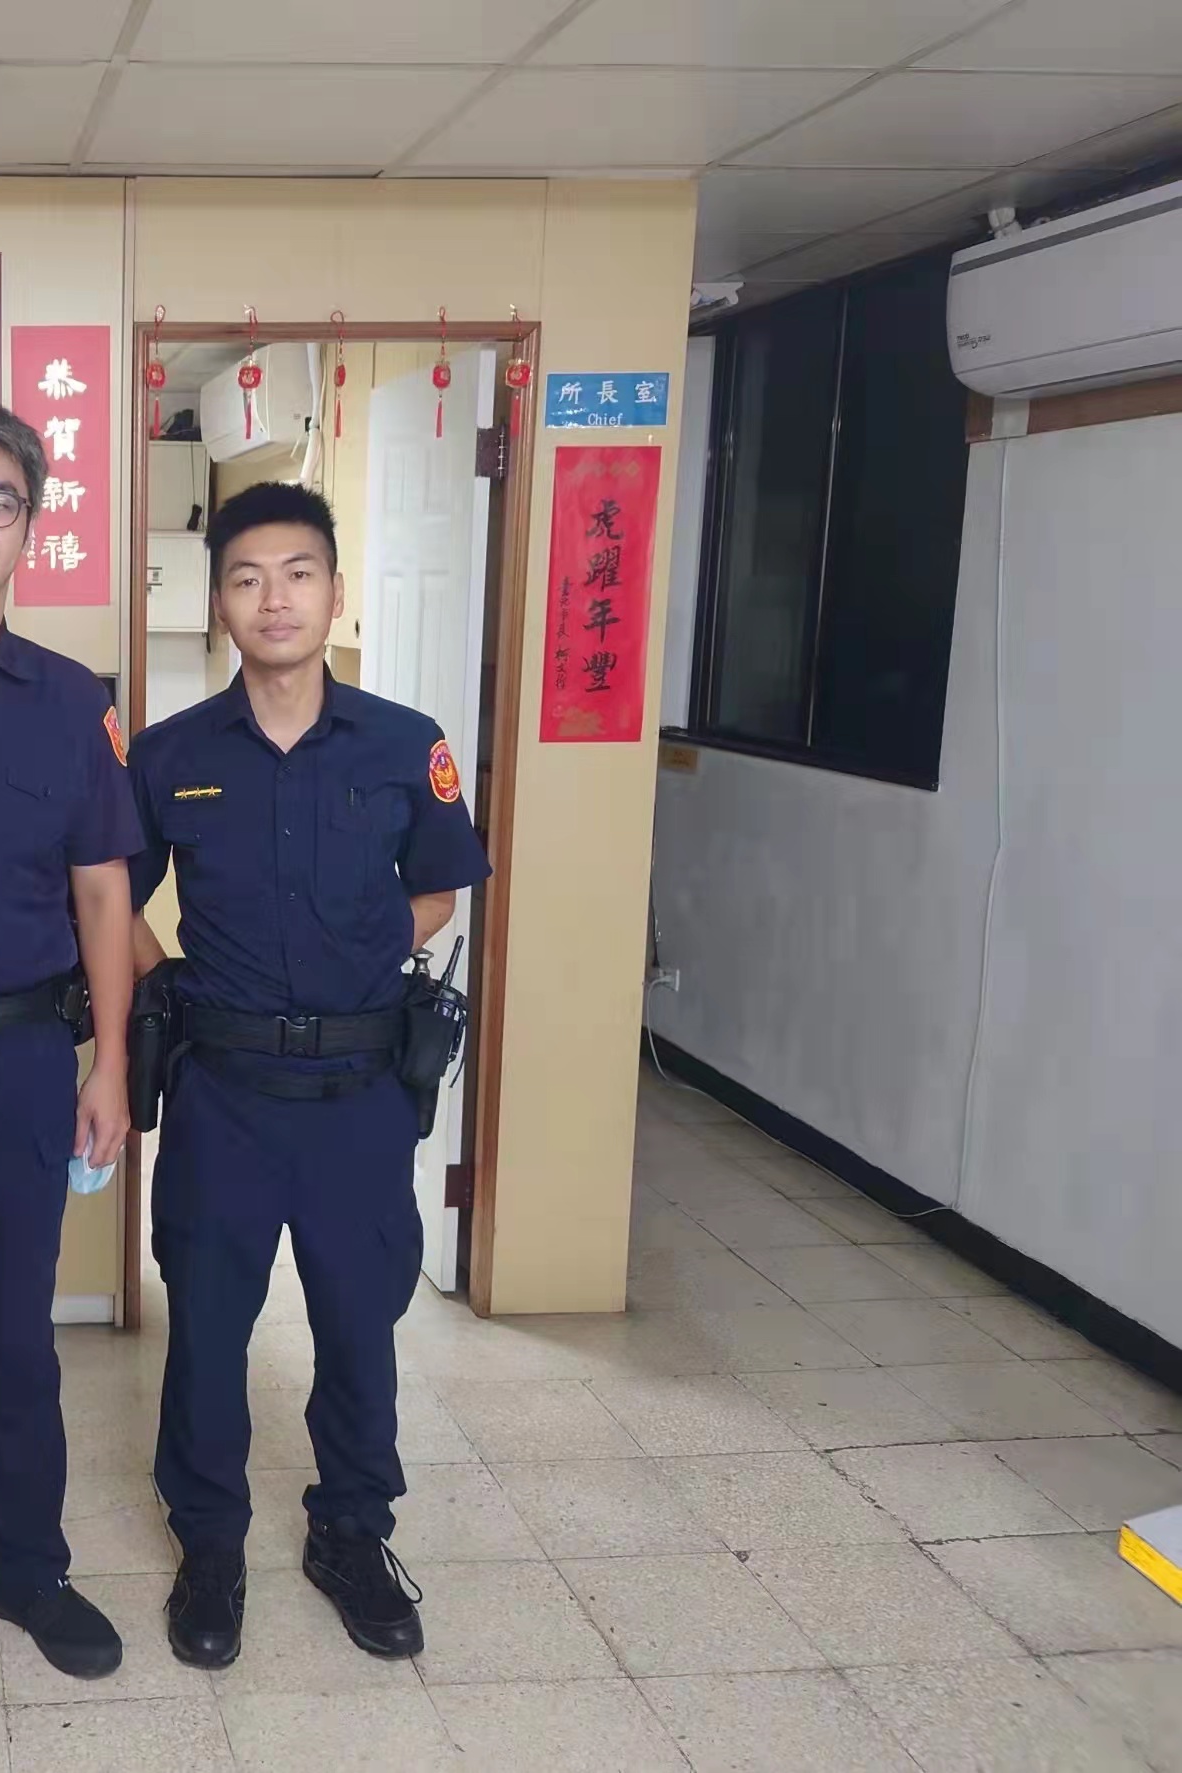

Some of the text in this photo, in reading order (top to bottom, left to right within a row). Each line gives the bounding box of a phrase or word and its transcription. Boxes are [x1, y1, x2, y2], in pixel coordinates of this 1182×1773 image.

[559, 381, 656, 405] 所長室
[587, 412, 623, 426] Chief
[37, 358, 88, 572] 恭賀新禧
[582, 497, 623, 693] 虎躍年豐
